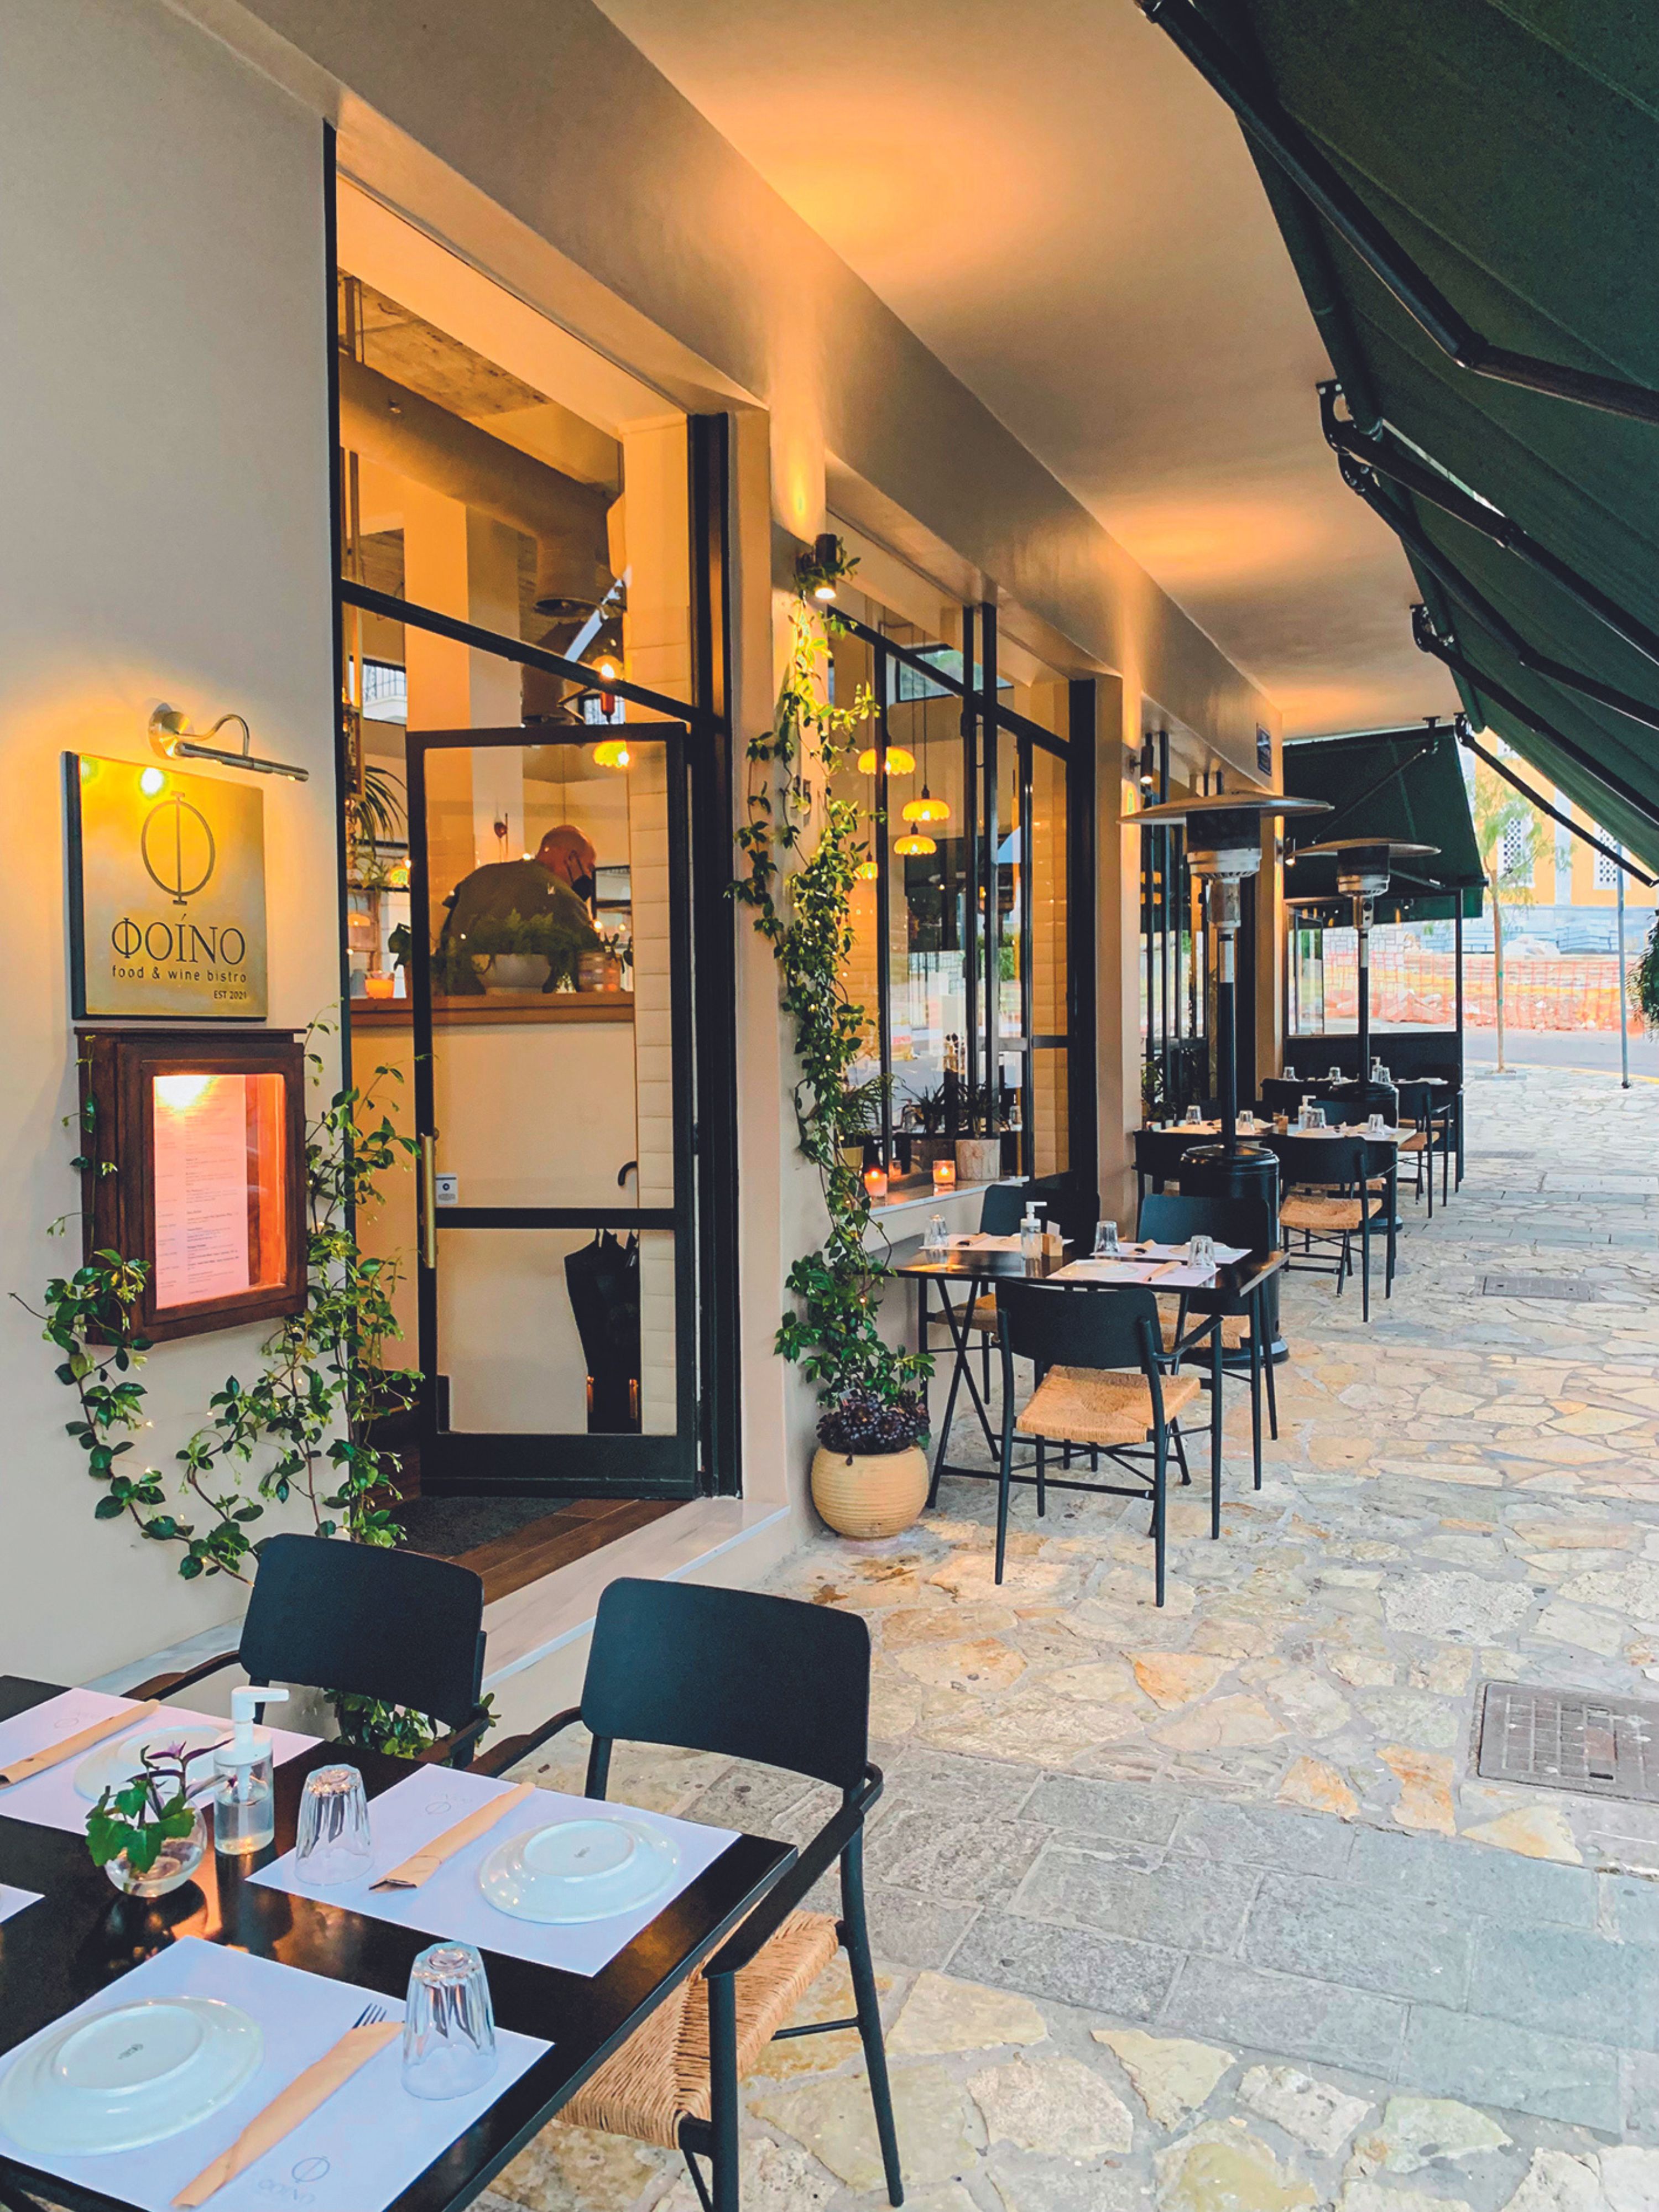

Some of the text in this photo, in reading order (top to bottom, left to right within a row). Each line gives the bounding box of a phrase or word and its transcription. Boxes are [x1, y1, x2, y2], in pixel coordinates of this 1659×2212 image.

[112, 965, 247, 983] food & wine bistro
[213, 990, 247, 999] EST 2021
